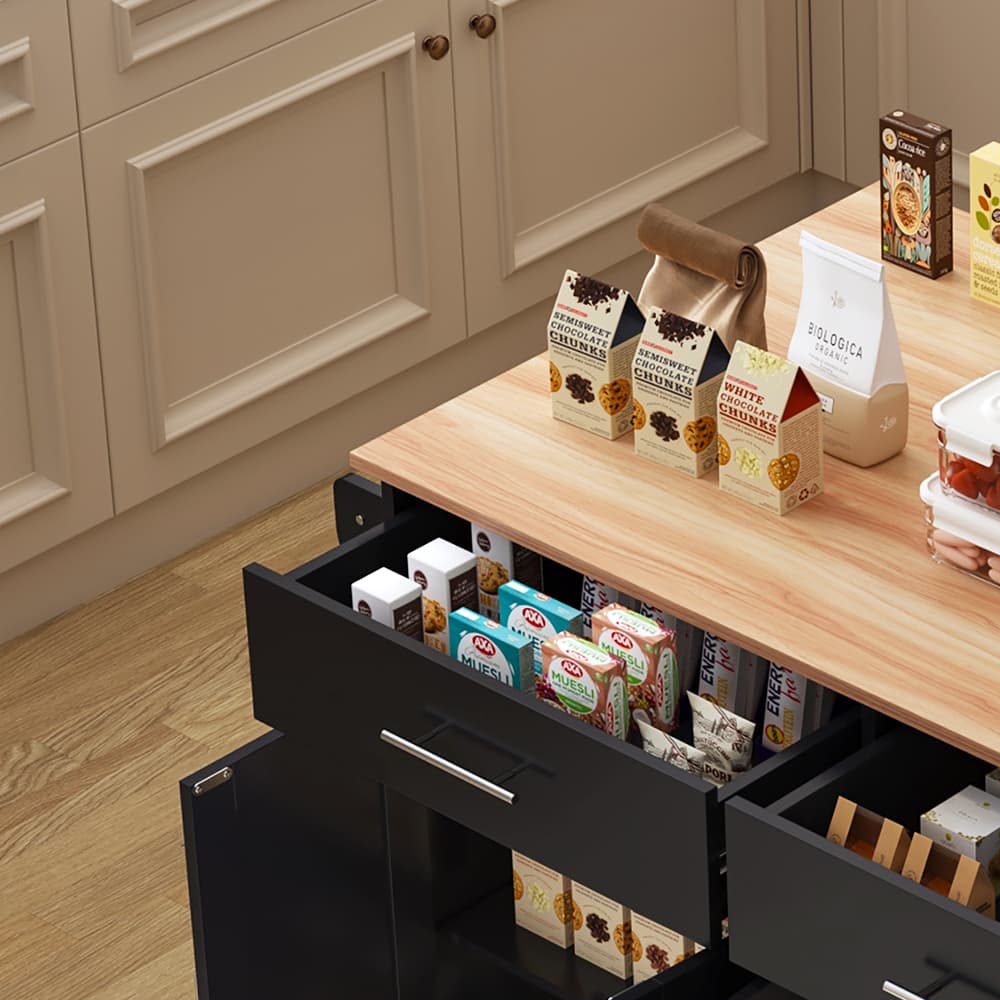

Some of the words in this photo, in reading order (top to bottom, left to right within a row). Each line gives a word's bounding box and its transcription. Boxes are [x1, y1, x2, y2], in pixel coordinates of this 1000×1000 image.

[550, 321, 608, 348] CHOCOLATE
[553, 311, 612, 338] SEMISWEET
[549, 331, 607, 359] CHUNKS
[808, 321, 863, 359] BIOLOGICA
[815, 342, 849, 365] ORGANIC
[635, 358, 694, 385] CHOCOLATE
[637, 348, 697, 376] SEMISWEET
[634, 367, 692, 396] CHUNKS
[724, 382, 765, 405] WHITE
[719, 402, 777, 433] CHUNKS
[720, 393, 779, 422] CHOCOLATE
[551, 670, 595, 698] MUESLI
